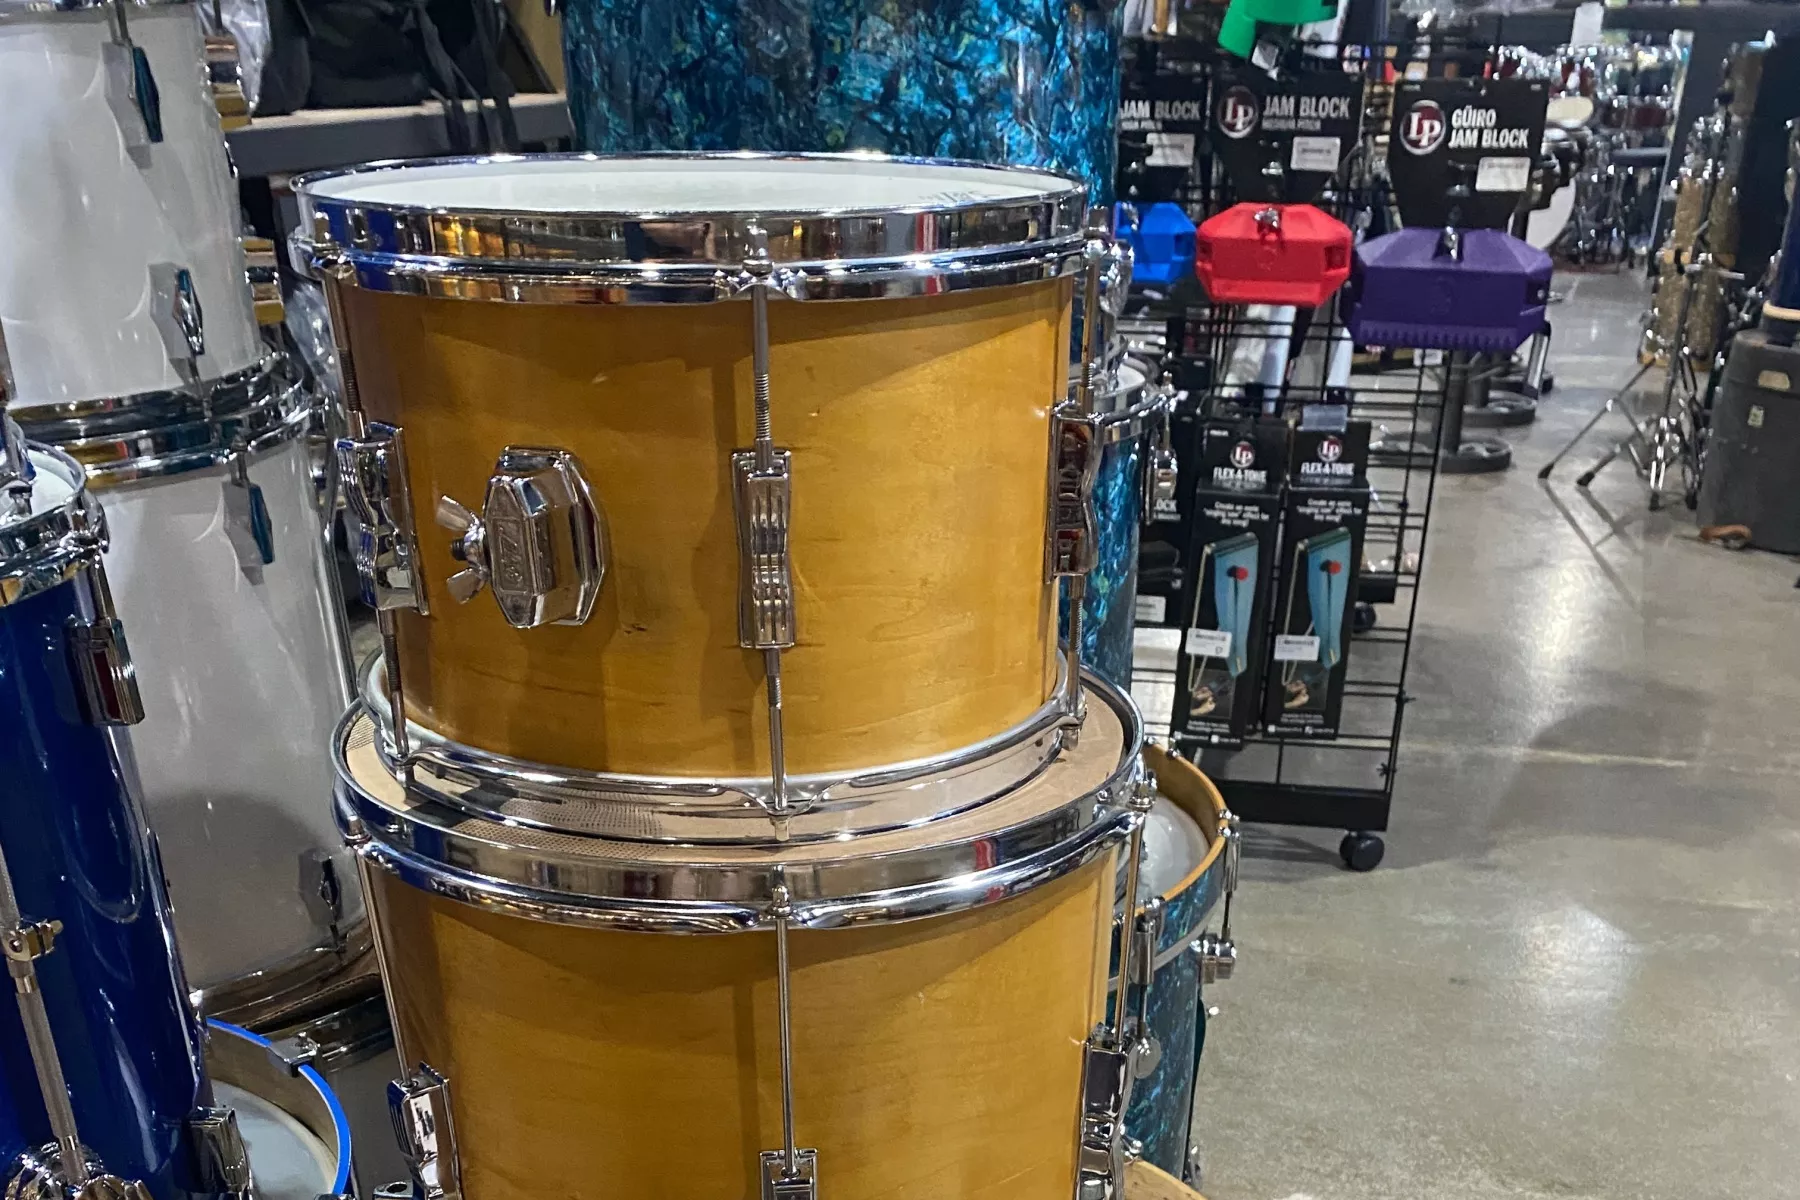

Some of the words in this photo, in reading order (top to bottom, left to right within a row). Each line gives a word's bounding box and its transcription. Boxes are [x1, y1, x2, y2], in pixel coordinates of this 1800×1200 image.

[1120, 100, 1150, 119] JAM
[1154, 100, 1200, 120] BLOCK
[1263, 96, 1295, 116] JAM
[1299, 97, 1350, 120] BLOCK
[1451, 105, 1497, 128] GÜIRO
[1448, 128, 1479, 149] JAM
[1482, 128, 1530, 149] BLOCK
